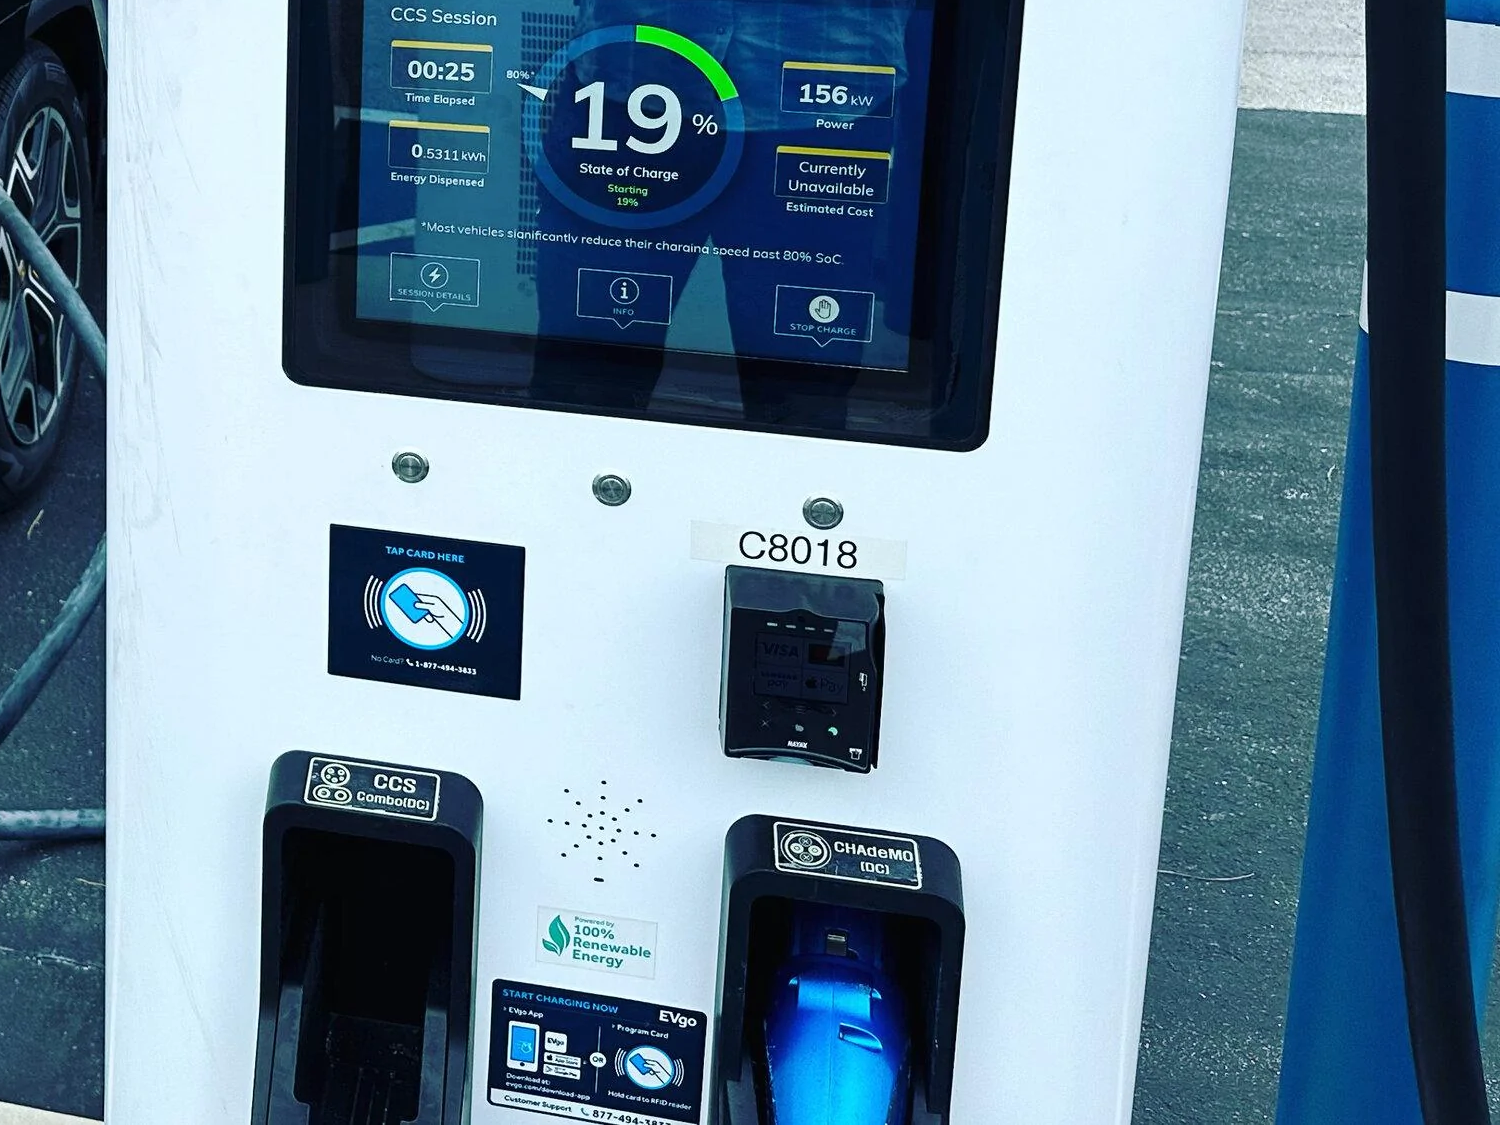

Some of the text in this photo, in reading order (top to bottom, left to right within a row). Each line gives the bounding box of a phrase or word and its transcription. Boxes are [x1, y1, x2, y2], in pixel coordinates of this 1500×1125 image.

[391, 7, 497, 26] CCS Session
[407, 60, 475, 82] 00:25
[405, 92, 475, 106] Time Elapsed
[799, 83, 873, 107] 156 kW
[571, 81, 718, 155] 19 %
[816, 119, 854, 131] Power
[411, 144, 486, 162] 0.5311 kWh
[579, 163, 679, 181] State of Charge
[799, 161, 866, 179] Currently
[390, 172, 484, 188] Energy Dispensed
[788, 180, 874, 197] Unavailable
[607, 184, 648, 197] Starting
[616, 196, 638, 207] 19%
[786, 202, 874, 218] Estimated Cost
[457, 225, 504, 238] vehicles
[507, 229, 578, 244] significantly
[581, 236, 622, 248] reduce
[624, 238, 652, 249] their
[655, 241, 709, 255] charging
[712, 247, 750, 257] speed
[753, 250, 780, 260] past
[783, 251, 812, 262] 80%
[397, 288, 471, 301] SESSION DETAILS
[613, 307, 634, 316] INFO
[790, 322, 857, 336] STOP CHARGE
[385, 546, 465, 563] TAP CARD HERE
[739, 531, 858, 569] C8018
[761, 642, 798, 658] VISA
[370, 654, 382, 662] No
[383, 655, 404, 665] Card?
[373, 773, 417, 794] CCS
[833, 841, 914, 862] CHAdeMO
[574, 916, 605, 926] Powered
[574, 925, 615, 940] 100%
[573, 936, 651, 958] Renewable
[572, 949, 624, 969] Energy
[502, 988, 619, 1014] START CHARGING NOW
[508, 1006, 544, 1019] EVgo App
[659, 1009, 698, 1028] EVgo
[617, 1023, 669, 1039] Program Card
[506, 1072, 540, 1084] Download
[504, 1094, 540, 1107] Customer
[542, 1101, 572, 1113] Support
[608, 1090, 625, 1098] Hold
[625, 1094, 641, 1102] card
[668, 1101, 692, 1112] reader
